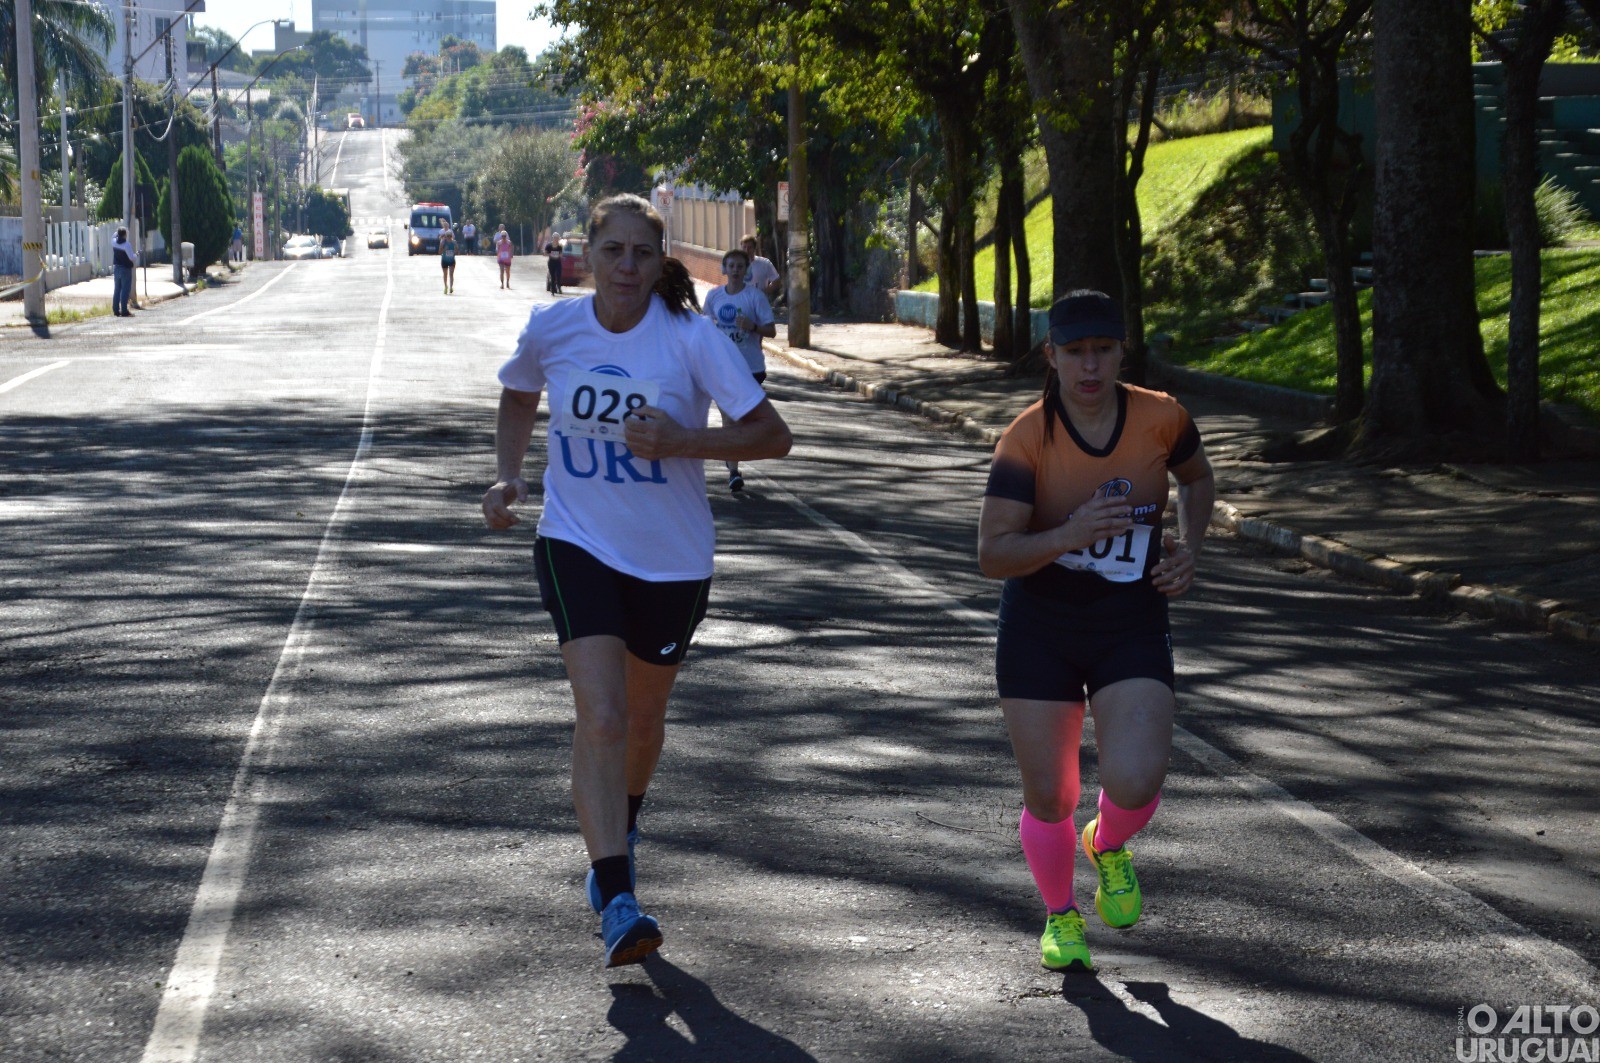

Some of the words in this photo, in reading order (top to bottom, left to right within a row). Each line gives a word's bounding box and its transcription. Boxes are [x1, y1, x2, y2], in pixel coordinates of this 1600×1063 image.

[254, 197, 263, 253] MERCADO
[571, 384, 648, 424] 028
[1066, 527, 1136, 564] 01
